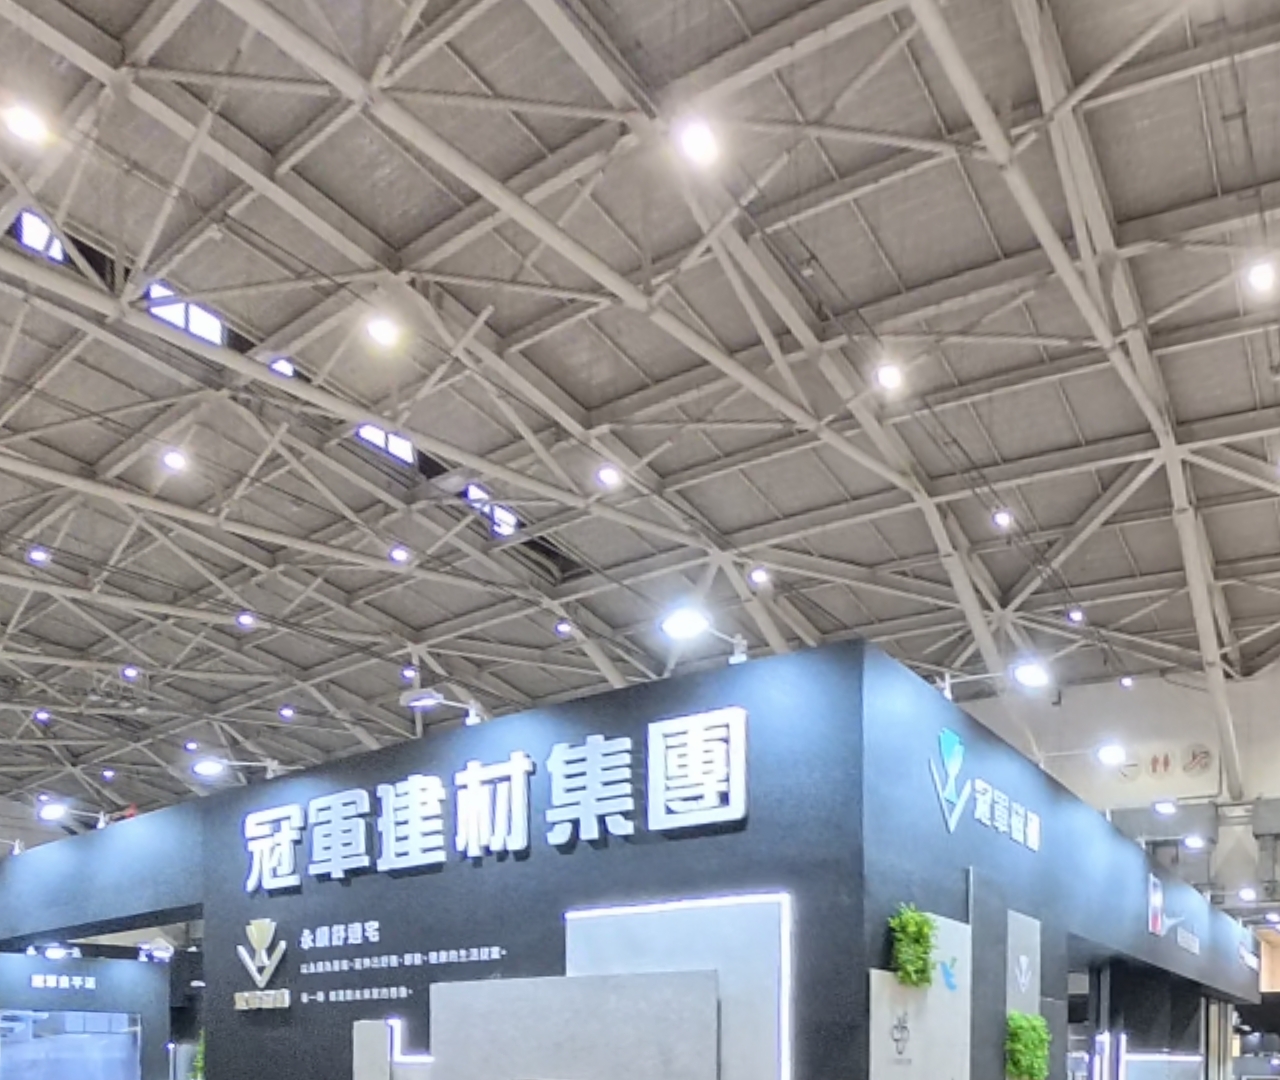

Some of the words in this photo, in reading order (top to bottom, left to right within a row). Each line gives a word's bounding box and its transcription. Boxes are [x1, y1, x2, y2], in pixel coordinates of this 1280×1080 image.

[243, 705, 749, 893] 冠軍建材集團
